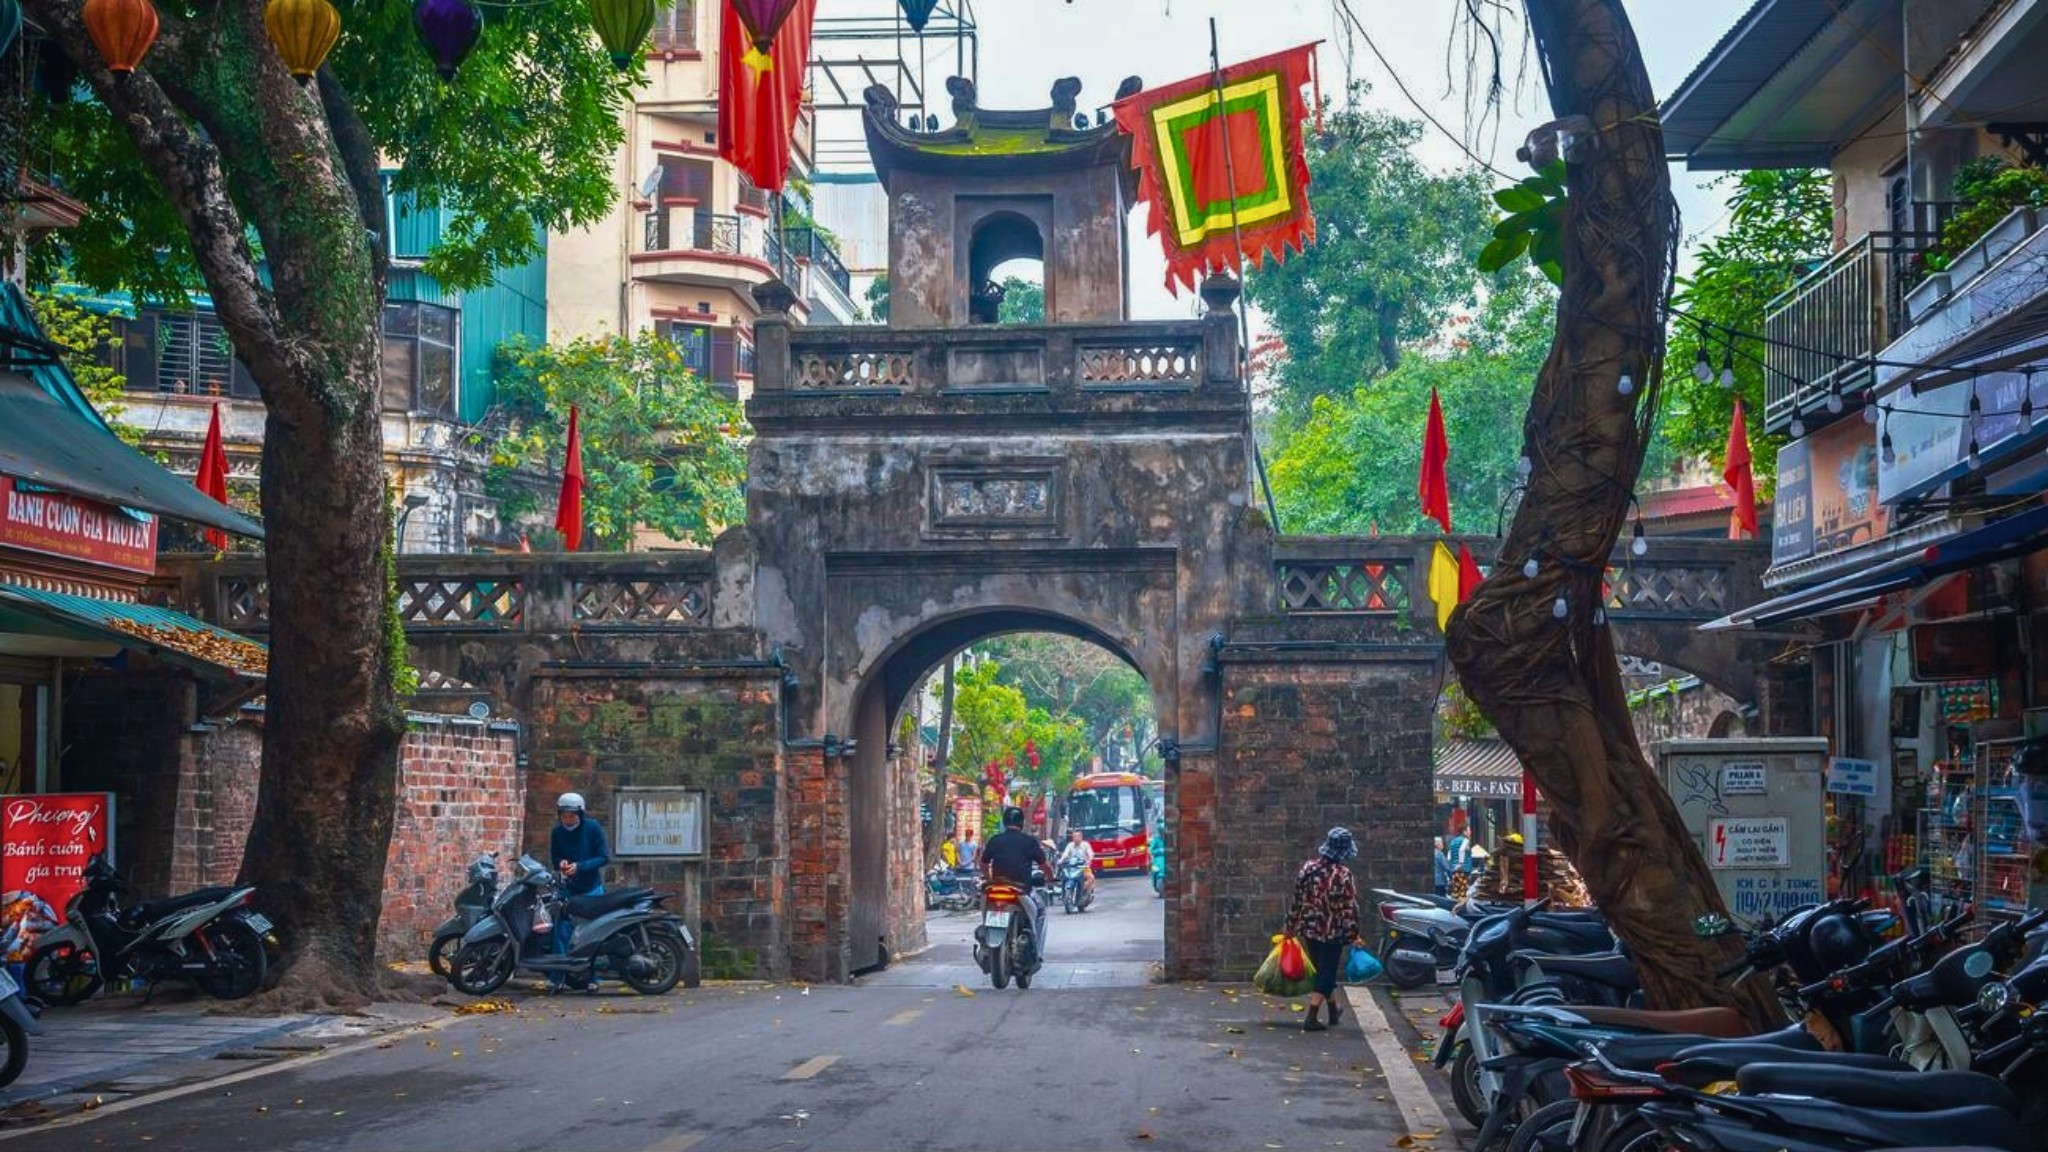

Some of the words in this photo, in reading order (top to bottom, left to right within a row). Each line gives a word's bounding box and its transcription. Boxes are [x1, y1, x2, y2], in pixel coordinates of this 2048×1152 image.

[83, 511, 103, 541] GIA
[1452, 780, 1481, 793] BEER
[1489, 781, 1519, 794] FAST
[4, 839, 44, 857] Bánh
